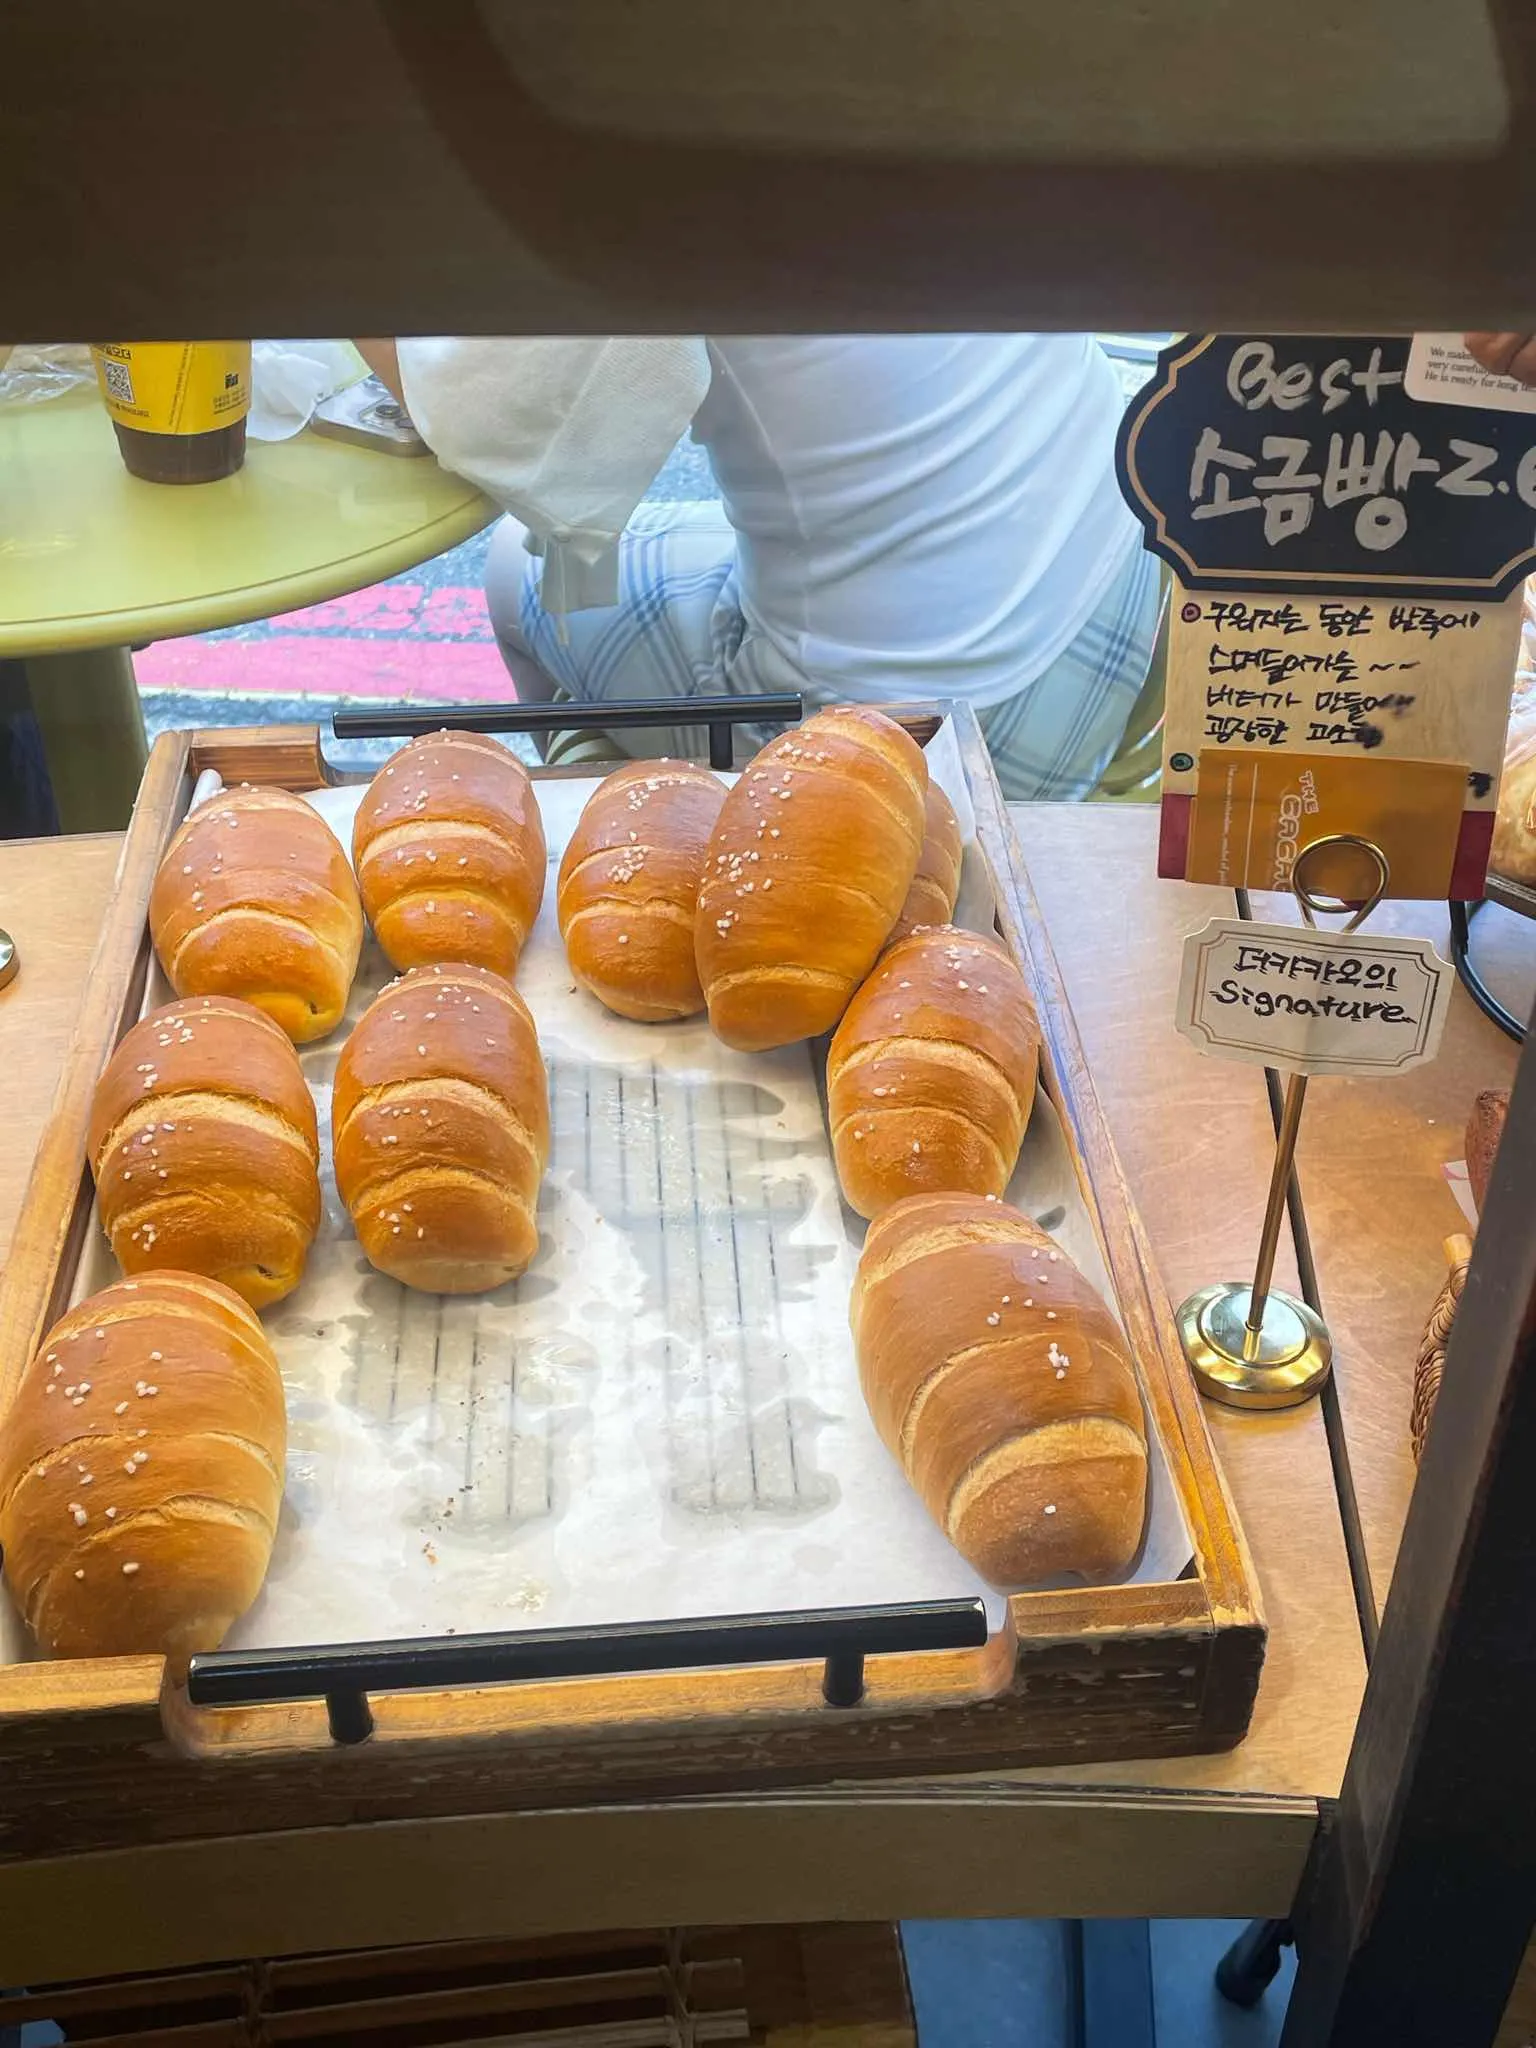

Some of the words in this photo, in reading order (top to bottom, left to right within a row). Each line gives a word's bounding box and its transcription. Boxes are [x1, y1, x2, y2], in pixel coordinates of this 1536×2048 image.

[1226, 341, 1403, 414] Best
[1189, 427, 1441, 551] 소금빵
[1319, 603, 1374, 638] 동안
[1208, 643, 1358, 684] 스며들어가는
[1206, 684, 1302, 709] 버터가
[1298, 769, 1320, 815] THE
[1208, 979, 1418, 1025] Signature
